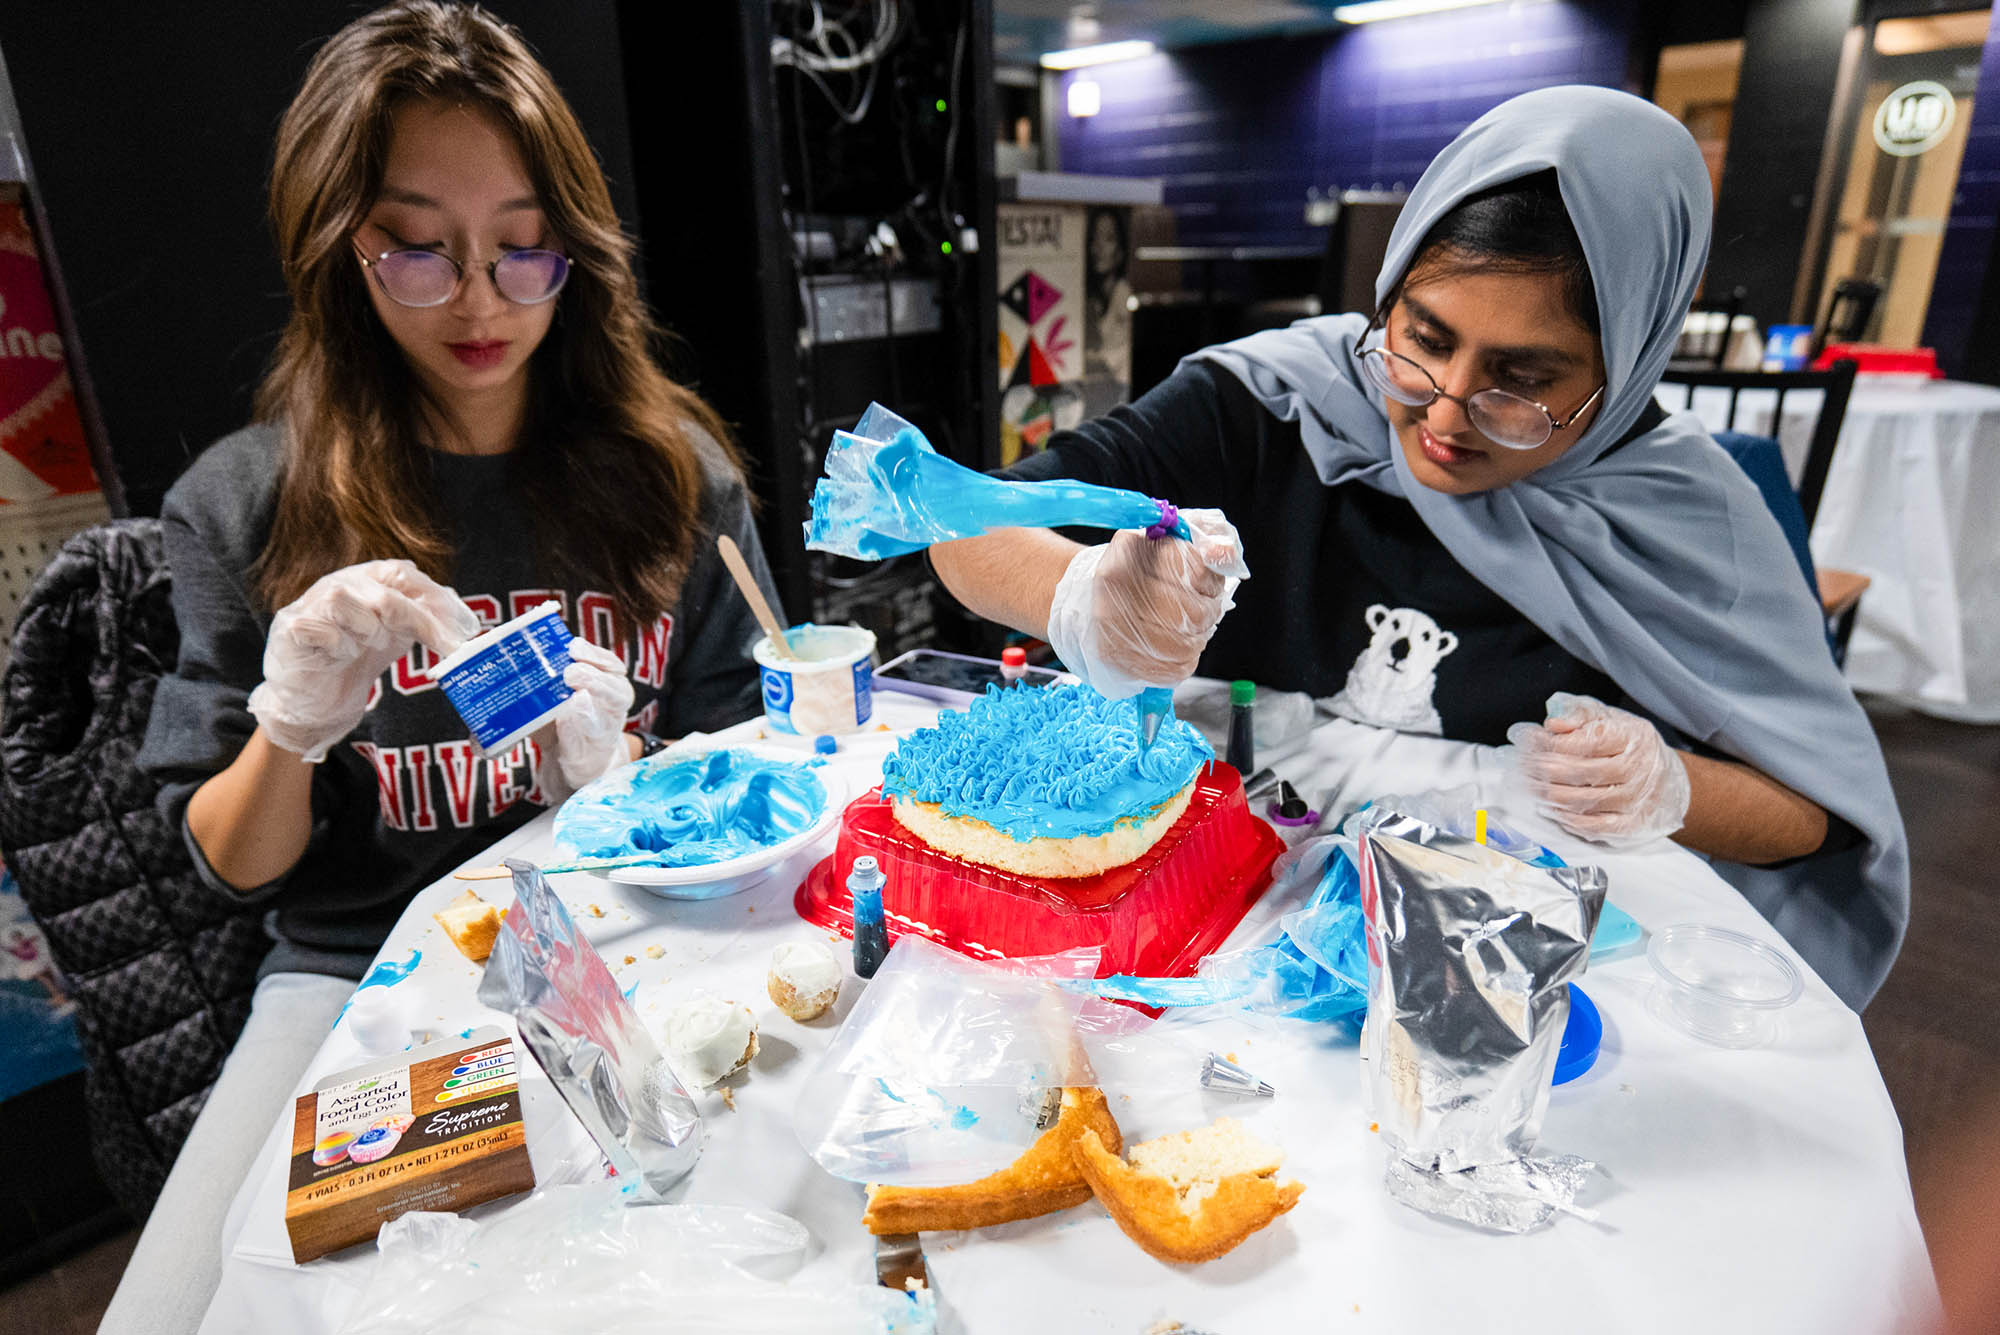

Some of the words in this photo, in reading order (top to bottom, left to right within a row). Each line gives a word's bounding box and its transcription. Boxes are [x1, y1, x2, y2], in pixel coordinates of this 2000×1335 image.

[477, 1057, 504, 1068] BLUE
[482, 1048, 502, 1057] RED
[461, 1078, 504, 1094] YELLOW
[467, 1068, 504, 1081] GREEN
[320, 1102, 359, 1121] Food
[364, 1090, 408, 1107] Color
[331, 1081, 398, 1108] Assorted
[329, 1115, 349, 1127] and
[353, 1110, 372, 1121] Egg
[375, 1103, 397, 1113] Dye
[424, 1101, 510, 1134] Supreme
[315, 1183, 340, 1198] VIALS
[349, 1176, 365, 1187] 0.3
[367, 1172, 375, 1182] FL
[379, 1167, 393, 1177] OZ
[394, 1163, 405, 1172] EA
[416, 1155, 432, 1166] NET
[435, 1149, 449, 1160] 1.2
[451, 1147, 460, 1156] FL
[463, 1142, 475, 1152] OZ
[477, 1132, 508, 1148] (35mL)
